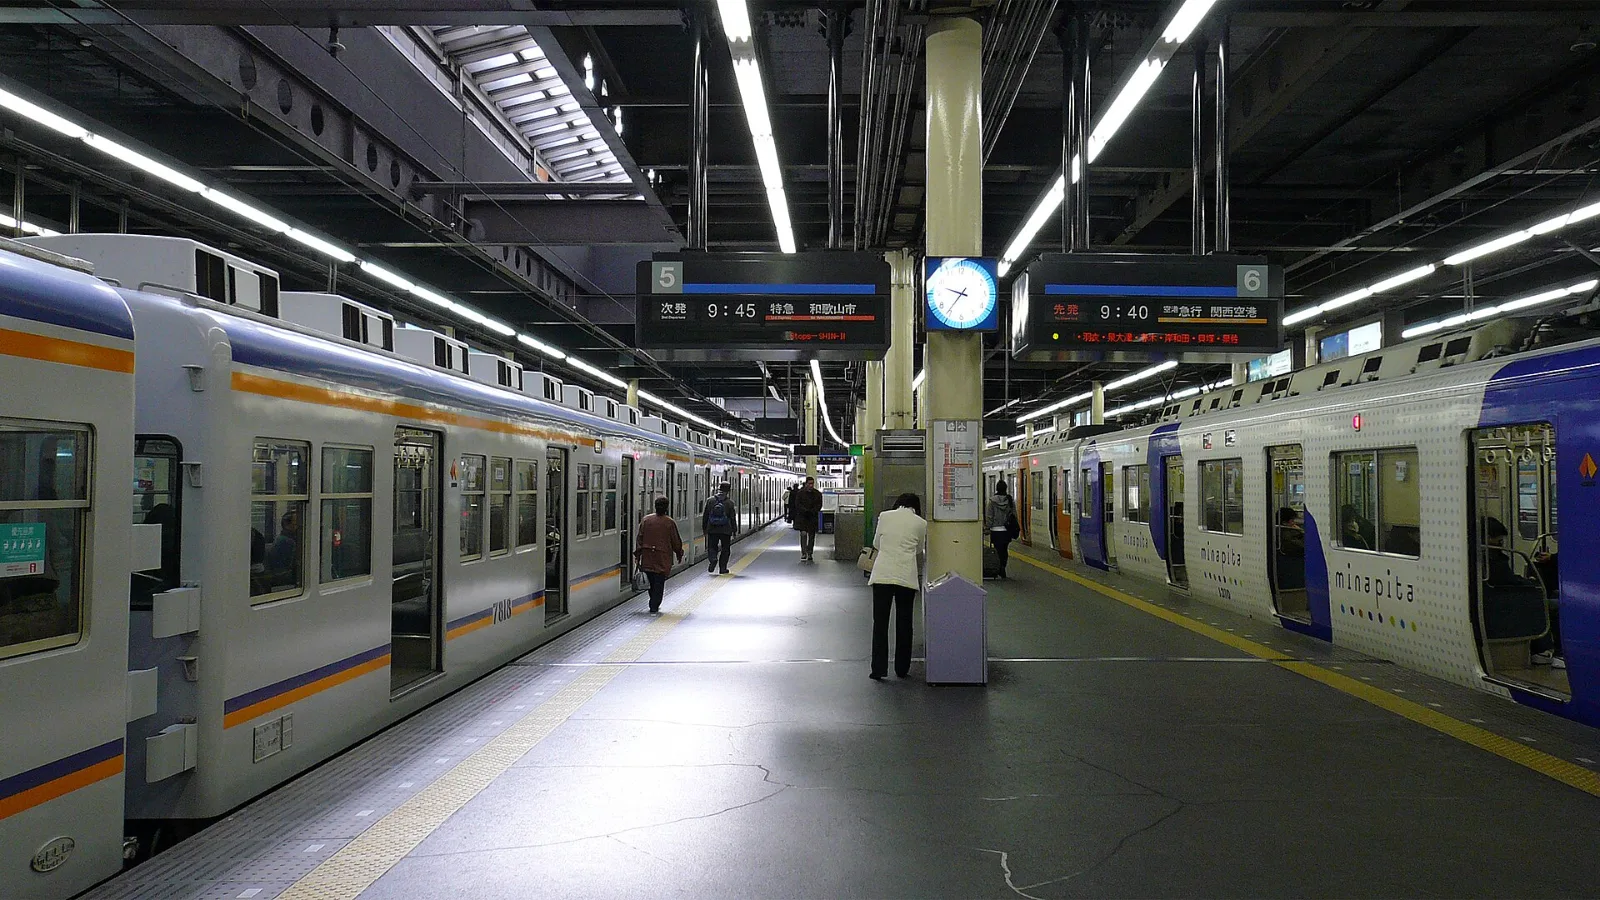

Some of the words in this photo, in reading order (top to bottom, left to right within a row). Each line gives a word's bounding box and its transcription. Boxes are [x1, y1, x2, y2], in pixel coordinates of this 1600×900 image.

[659, 266, 676, 288] 5
[1243, 269, 1261, 291] 6
[661, 302, 687, 314] 次発
[707, 303, 756, 318] 9:45
[769, 303, 794, 315] 特急
[809, 303, 857, 315] 和歌山市
[1053, 304, 1079, 316] 先発
[1100, 305, 1149, 320] 9:40
[1210, 306, 1258, 318] 関西空港
[1200, 541, 1241, 573] minapita
[1335, 562, 1414, 610] minapita
[492, 598, 512, 625] 7818
